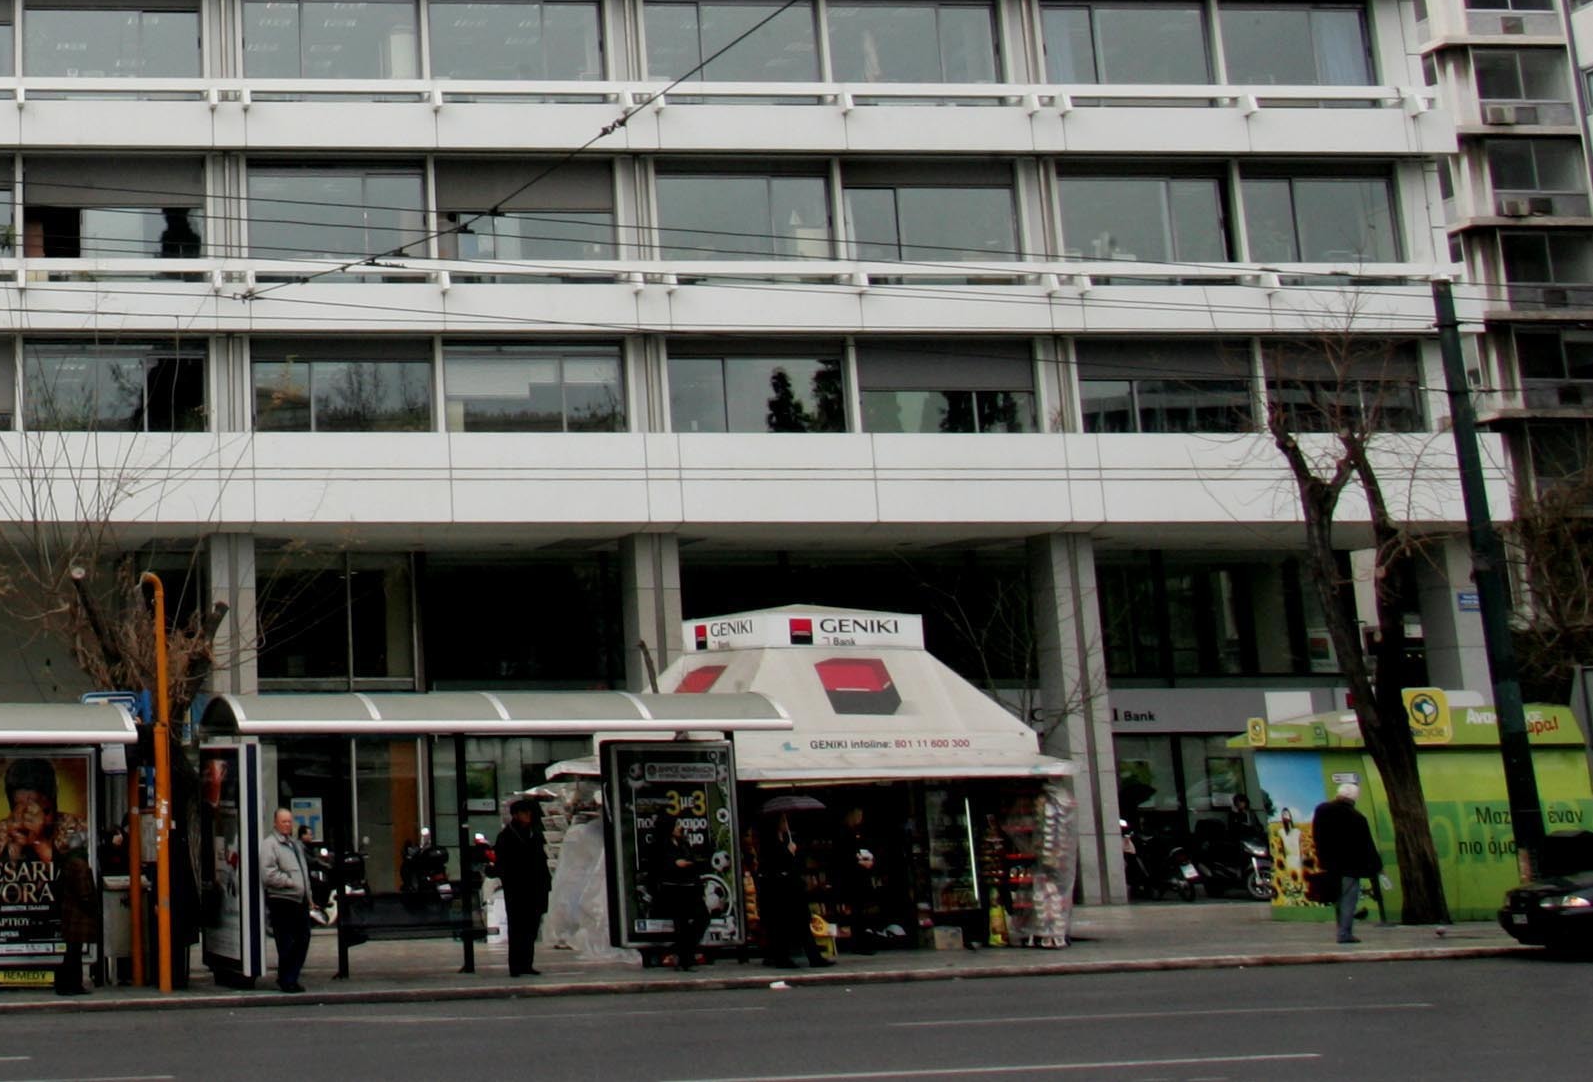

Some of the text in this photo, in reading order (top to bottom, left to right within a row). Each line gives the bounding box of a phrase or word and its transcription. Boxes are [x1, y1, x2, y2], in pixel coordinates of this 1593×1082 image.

[710, 619, 753, 637] GENIKI
[819, 618, 899, 633] GENIKI
[1123, 710, 1156, 722] Bank
[809, 739, 848, 750] GENIKI
[1474, 805, 1584, 825] Μαζ έναν
[1458, 839, 1484, 856] πιο
